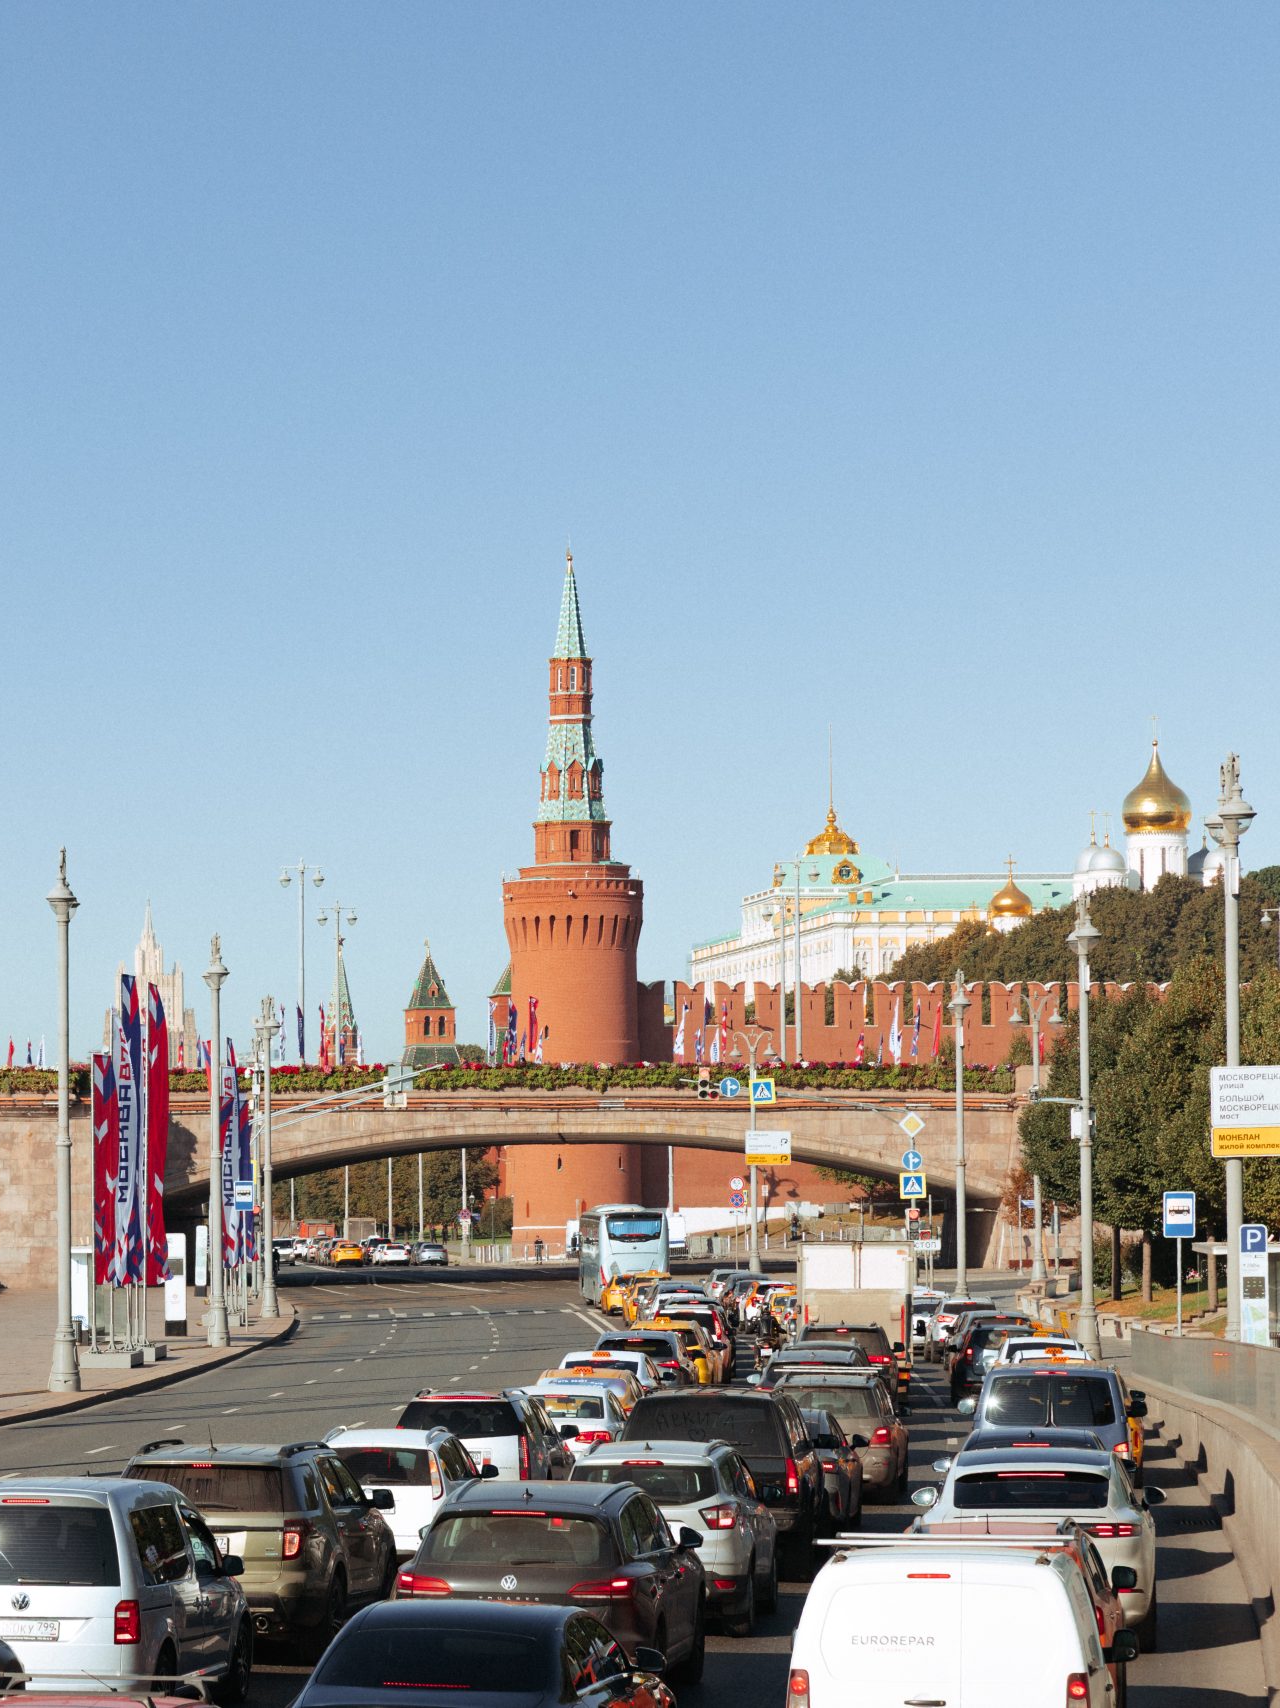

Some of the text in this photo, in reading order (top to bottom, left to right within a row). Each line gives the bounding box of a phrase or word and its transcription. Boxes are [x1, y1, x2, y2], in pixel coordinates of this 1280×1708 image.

[1219, 1083, 1244, 1091] улица
[1219, 1094, 1265, 1103] БОЛЬШОЙ
[1219, 1103, 1280, 1112] МОСКВОРЕЦК
[1218, 1133, 1260, 1141] МОНБЛАН
[117, 1084, 132, 1203] МОСКВА
[915, 1241, 937, 1249] СТОП
[37, 1621, 55, 1632] 799
[851, 1635, 935, 1646] EUROREPAR
